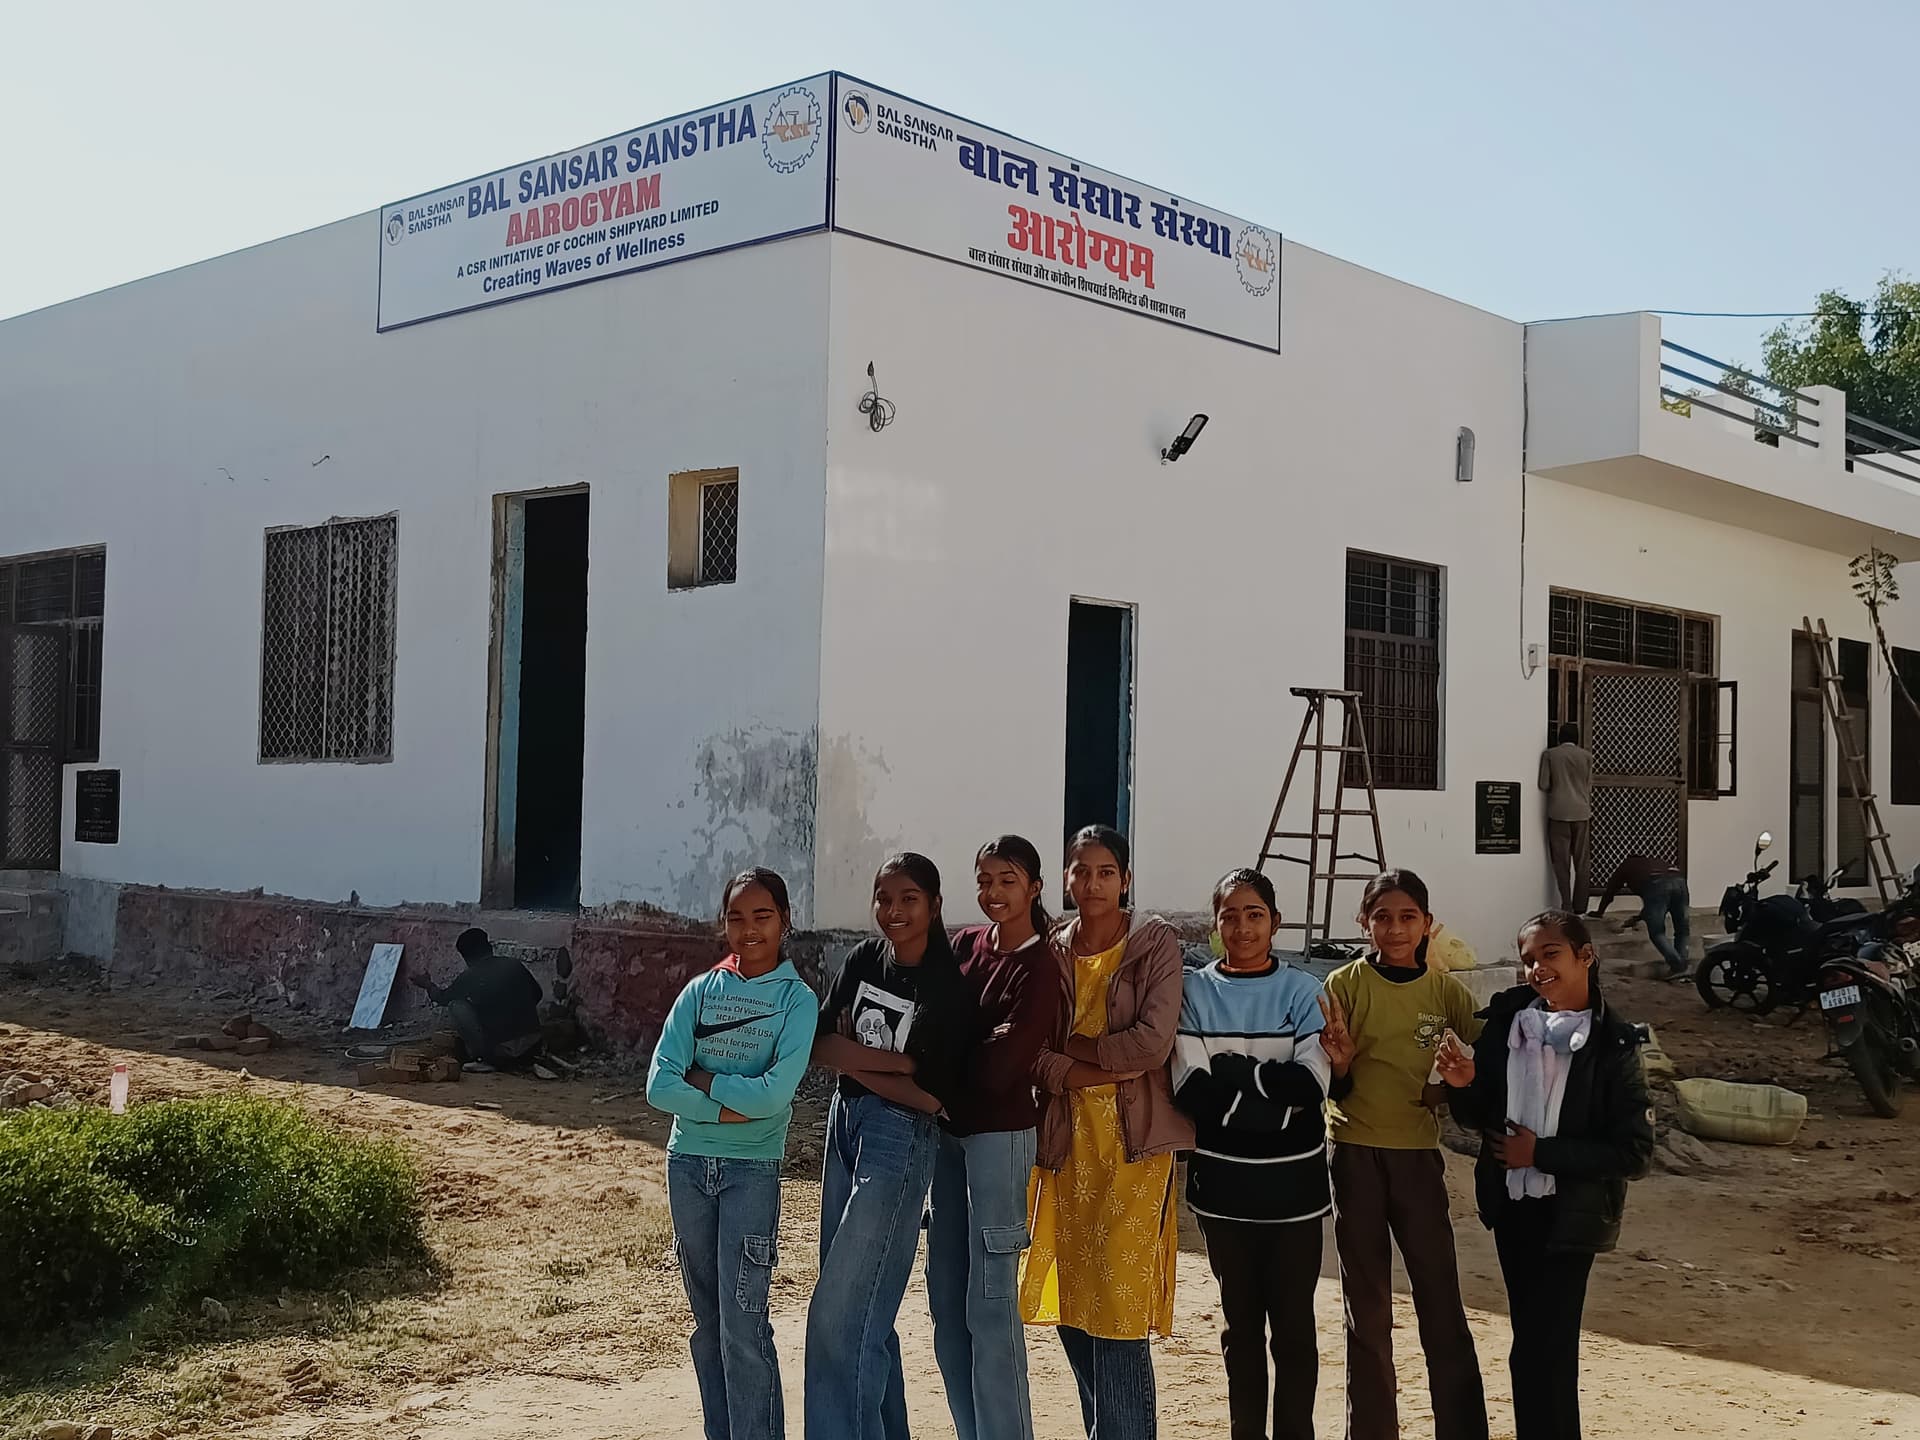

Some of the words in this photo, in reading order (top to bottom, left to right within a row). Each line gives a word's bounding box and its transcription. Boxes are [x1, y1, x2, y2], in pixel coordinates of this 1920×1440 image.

[877, 104, 901, 124] BAL
[904, 114, 953, 142] SANSAR
[877, 120, 937, 152] SANSTHA
[467, 178, 511, 219] BAL
[518, 145, 618, 204] SANSAR
[626, 104, 757, 173] SANSTHA
[408, 208, 426, 222] BAL
[427, 195, 465, 216] SANSAR
[408, 213, 452, 234] SANSTHA
[505, 173, 661, 247] AAROGYAM
[956, 134, 1039, 196] बाल
[1048, 163, 1142, 229] संसार
[1150, 198, 1232, 259] संस्था
[457, 266, 464, 279] A
[466, 260, 486, 275] CSR
[489, 245, 544, 270] INITIATIVE
[546, 240, 561, 255] OF
[563, 229, 606, 251] COCHIN
[609, 213, 667, 240] SHIPYARD
[670, 200, 719, 224] LIMITED
[483, 268, 541, 293] Creating
[545, 255, 592, 278] Waves
[596, 246, 612, 266] of
[615, 232, 686, 262] Wellness
[1007, 204, 1155, 290] आरोग्यम
[988, 250, 1010, 270] संसार
[1011, 257, 1033, 276] संस्था
[1033, 263, 1049, 281] और
[1138, 294, 1149, 309] की
[758, 1028, 774, 1040] USA
